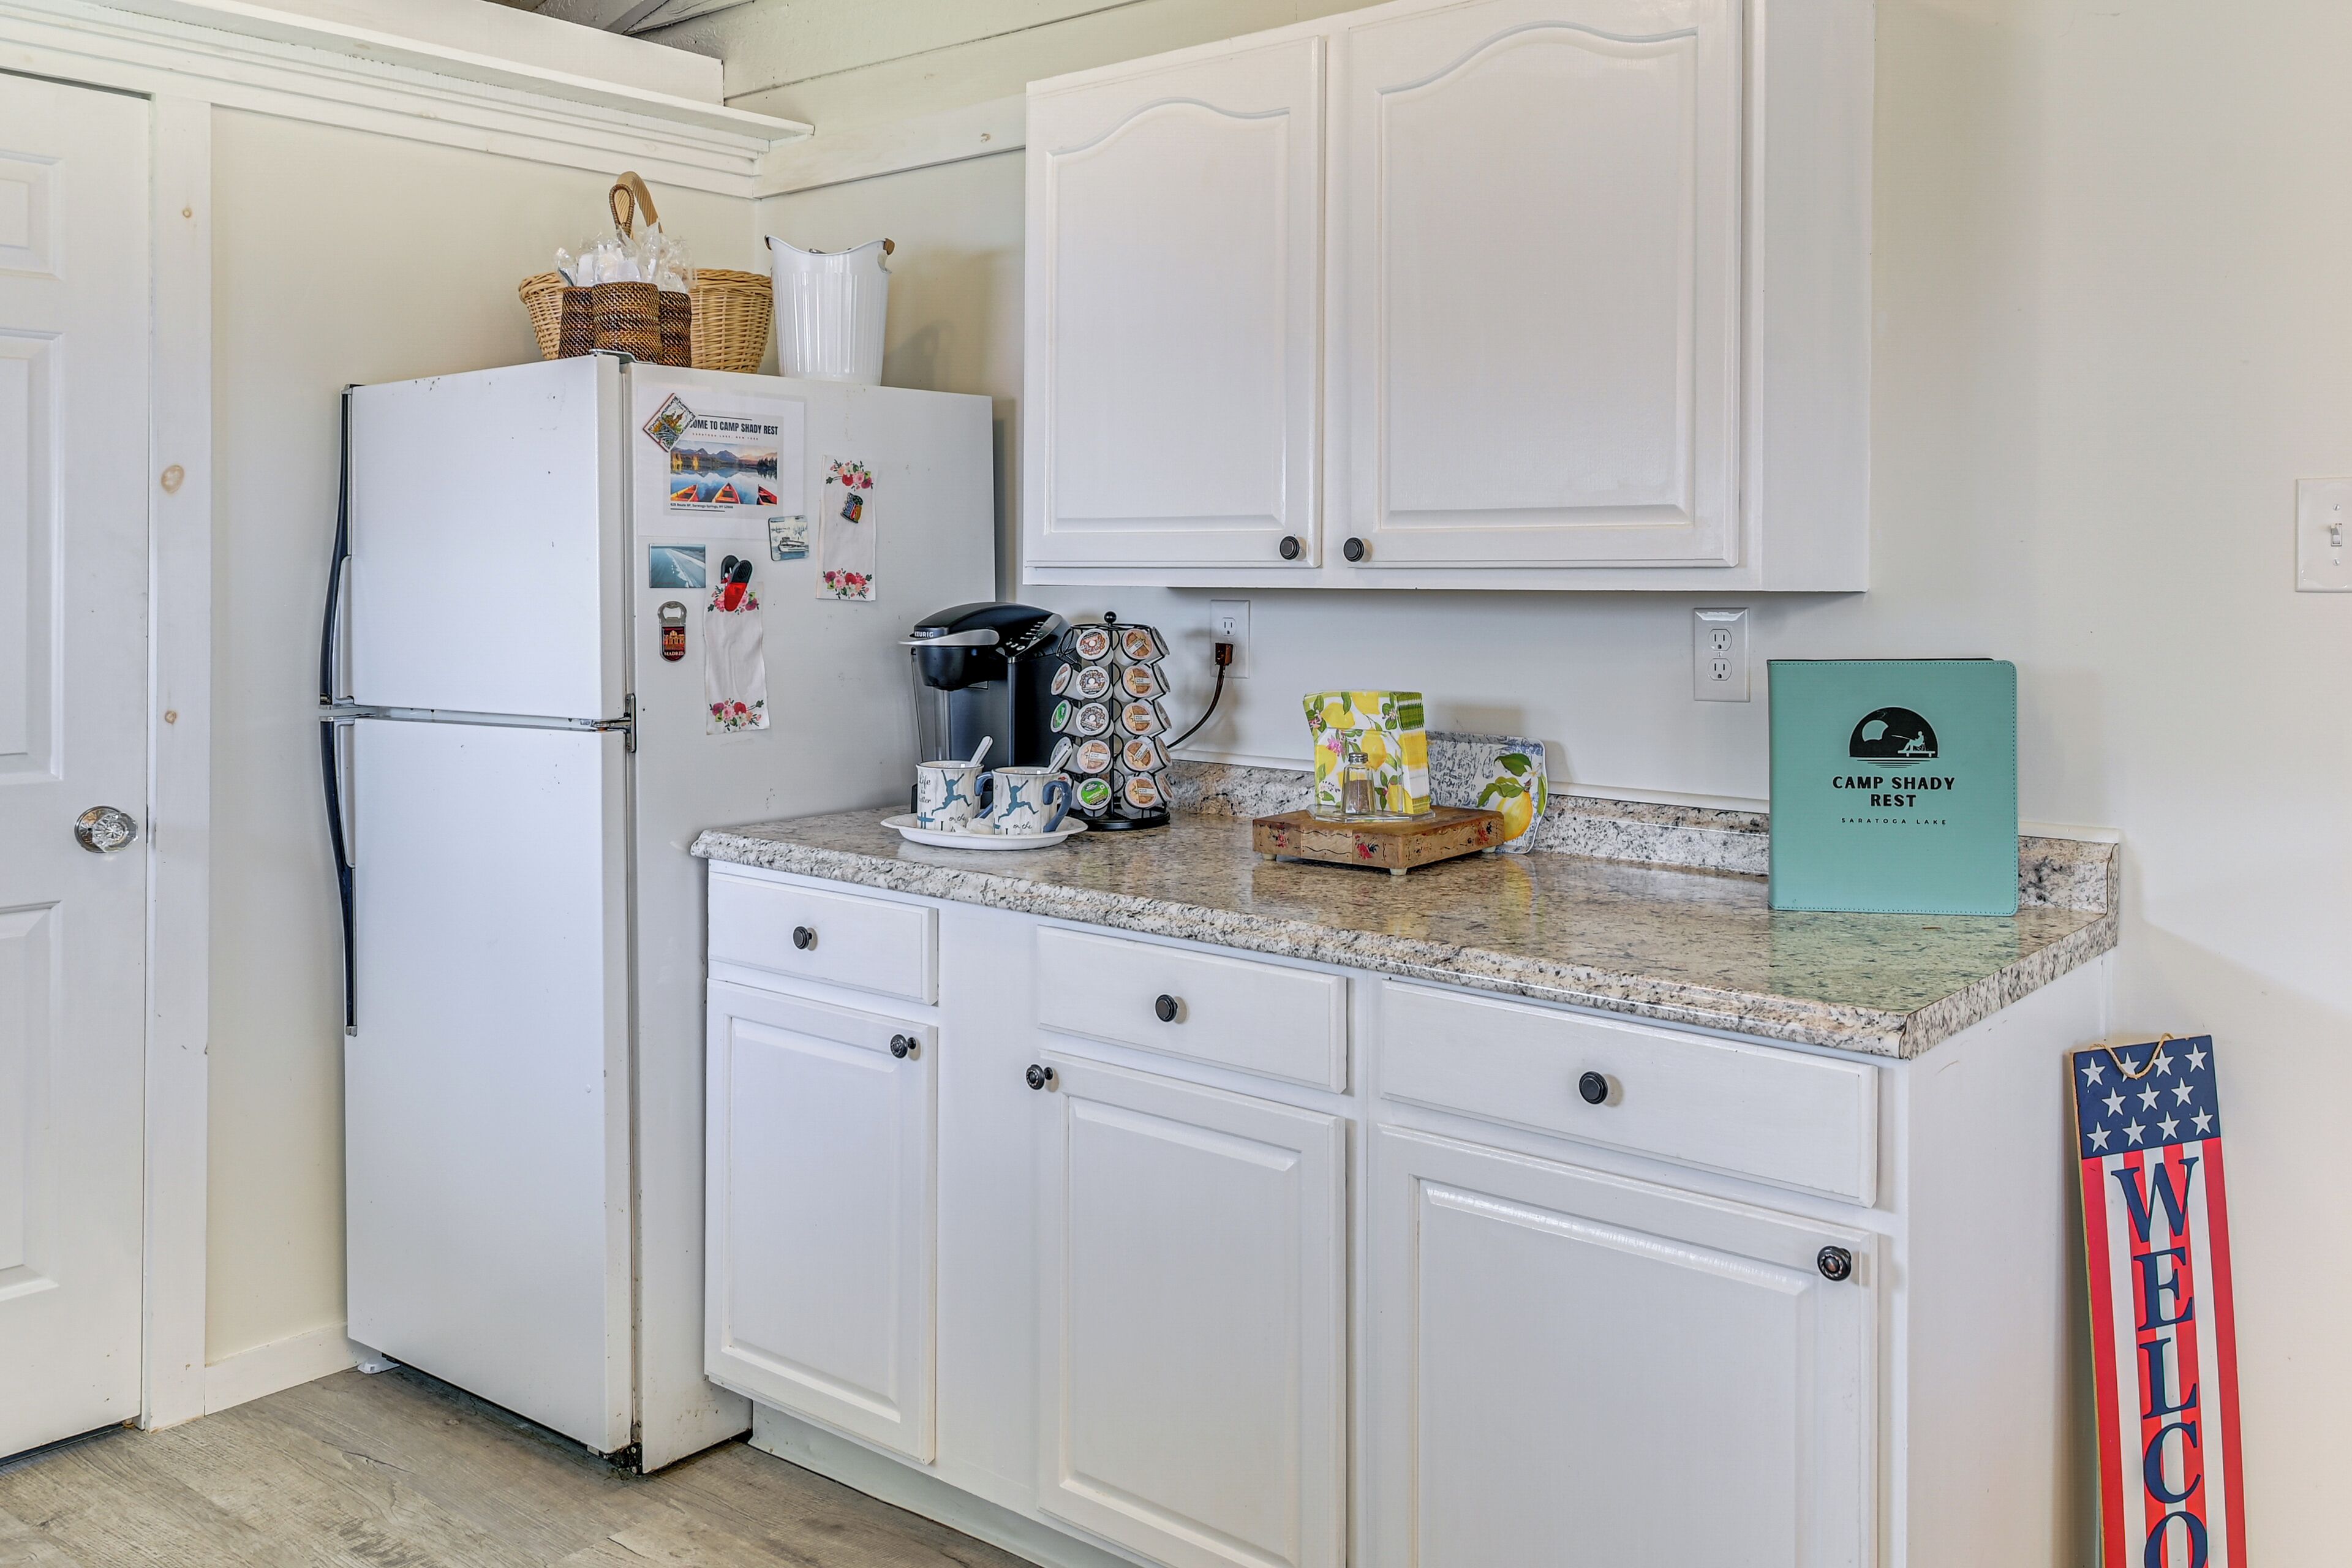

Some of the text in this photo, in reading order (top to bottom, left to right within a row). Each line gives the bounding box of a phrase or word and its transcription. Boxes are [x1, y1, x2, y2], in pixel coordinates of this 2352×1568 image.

[710, 420, 718, 430] TO
[720, 421, 739, 432] CAMP
[741, 423, 762, 434] SHADY
[763, 425, 778, 435] REST
[1832, 775, 1955, 790] CAMP SHADY
[1871, 793, 1917, 807] REST
